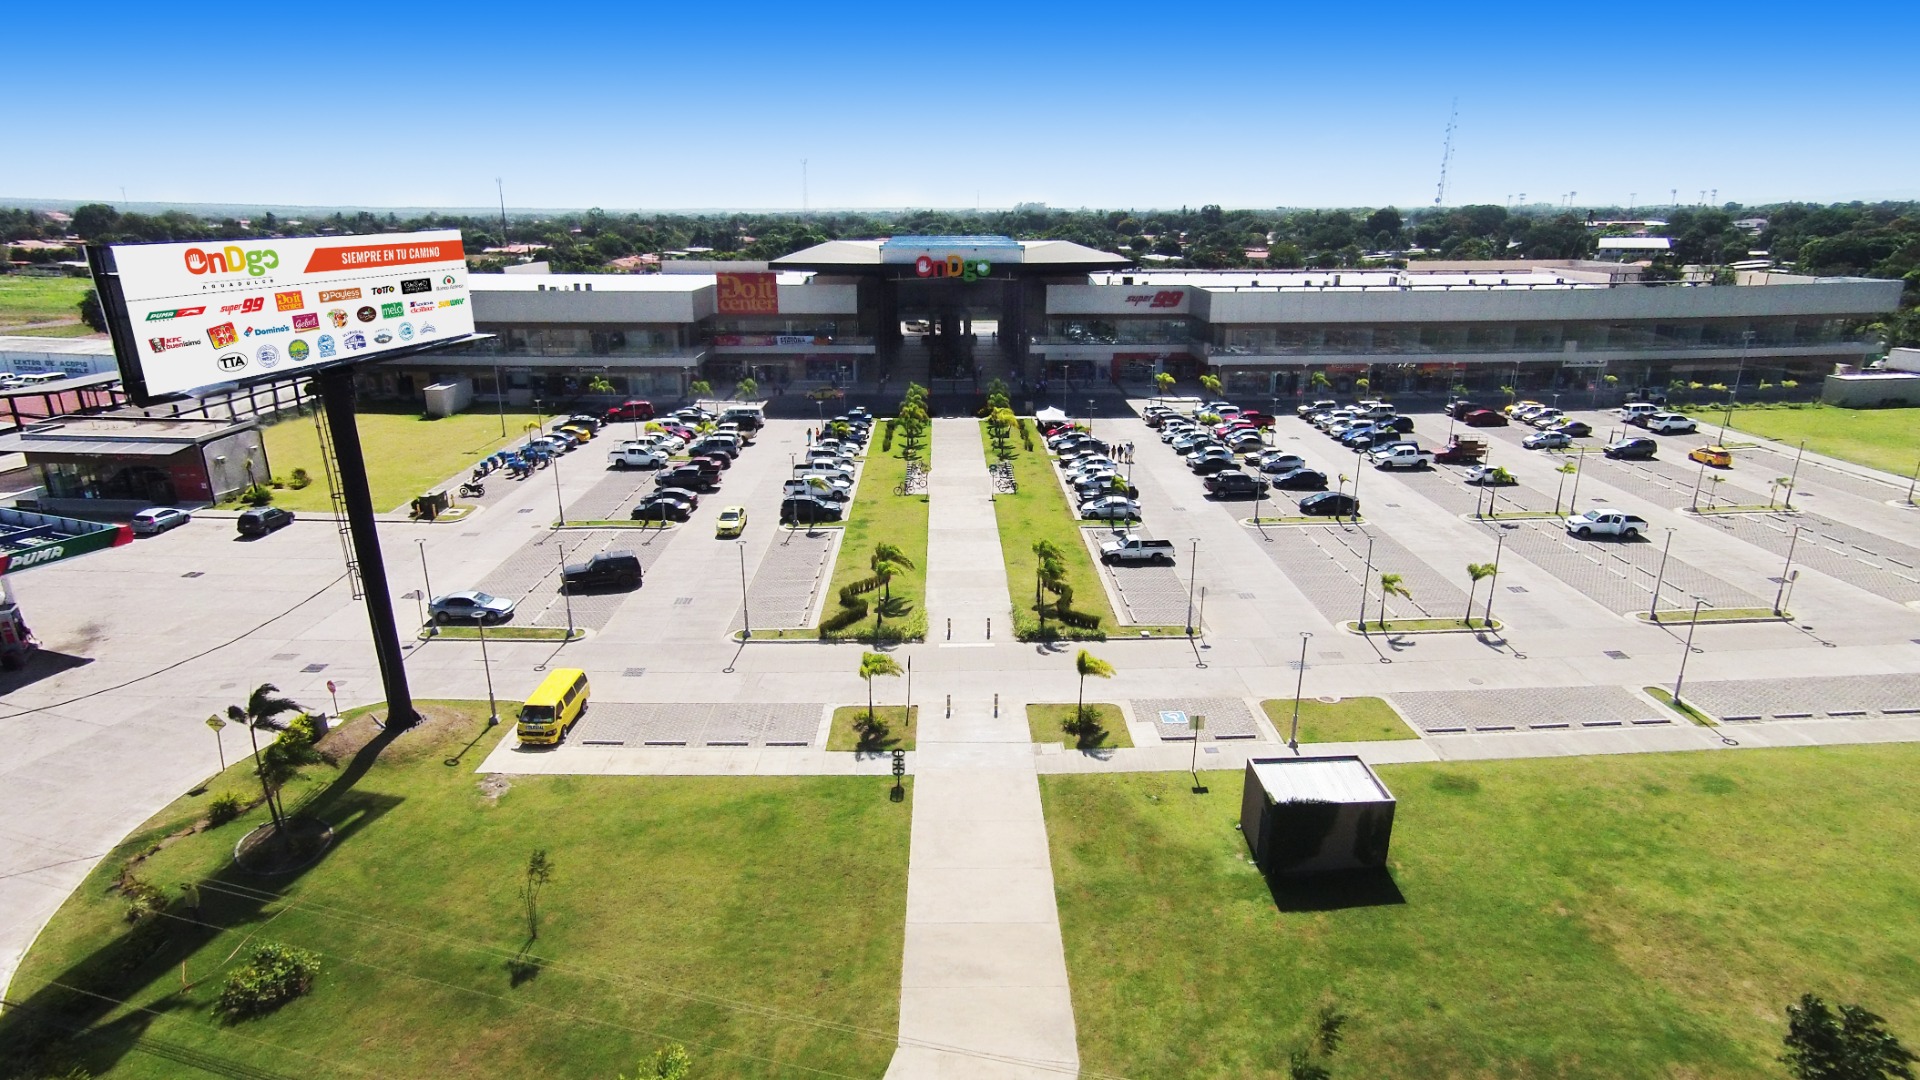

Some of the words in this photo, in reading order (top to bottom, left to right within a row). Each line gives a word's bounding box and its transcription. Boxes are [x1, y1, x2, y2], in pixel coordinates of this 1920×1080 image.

[341, 250, 382, 264] SIEMPRE
[383, 250, 394, 261] EN
[396, 249, 407, 260] TU
[409, 247, 440, 259] CAMINO
[720, 275, 757, 298] Do
[757, 277, 776, 298] it
[276, 293, 293, 305] Do
[292, 292, 302, 303] it
[329, 290, 360, 299] Payless
[1124, 295, 1154, 307] super
[1149, 291, 1185, 308] 99
[220, 303, 242, 315] super
[240, 297, 265, 314] 99
[382, 304, 403, 315] melo
[437, 298, 465, 309] SUBWAY
[720, 297, 777, 311] center
[254, 325, 290, 336] Domino's
[220, 356, 245, 368] TTA
[8, 545, 65, 570] PUMA
